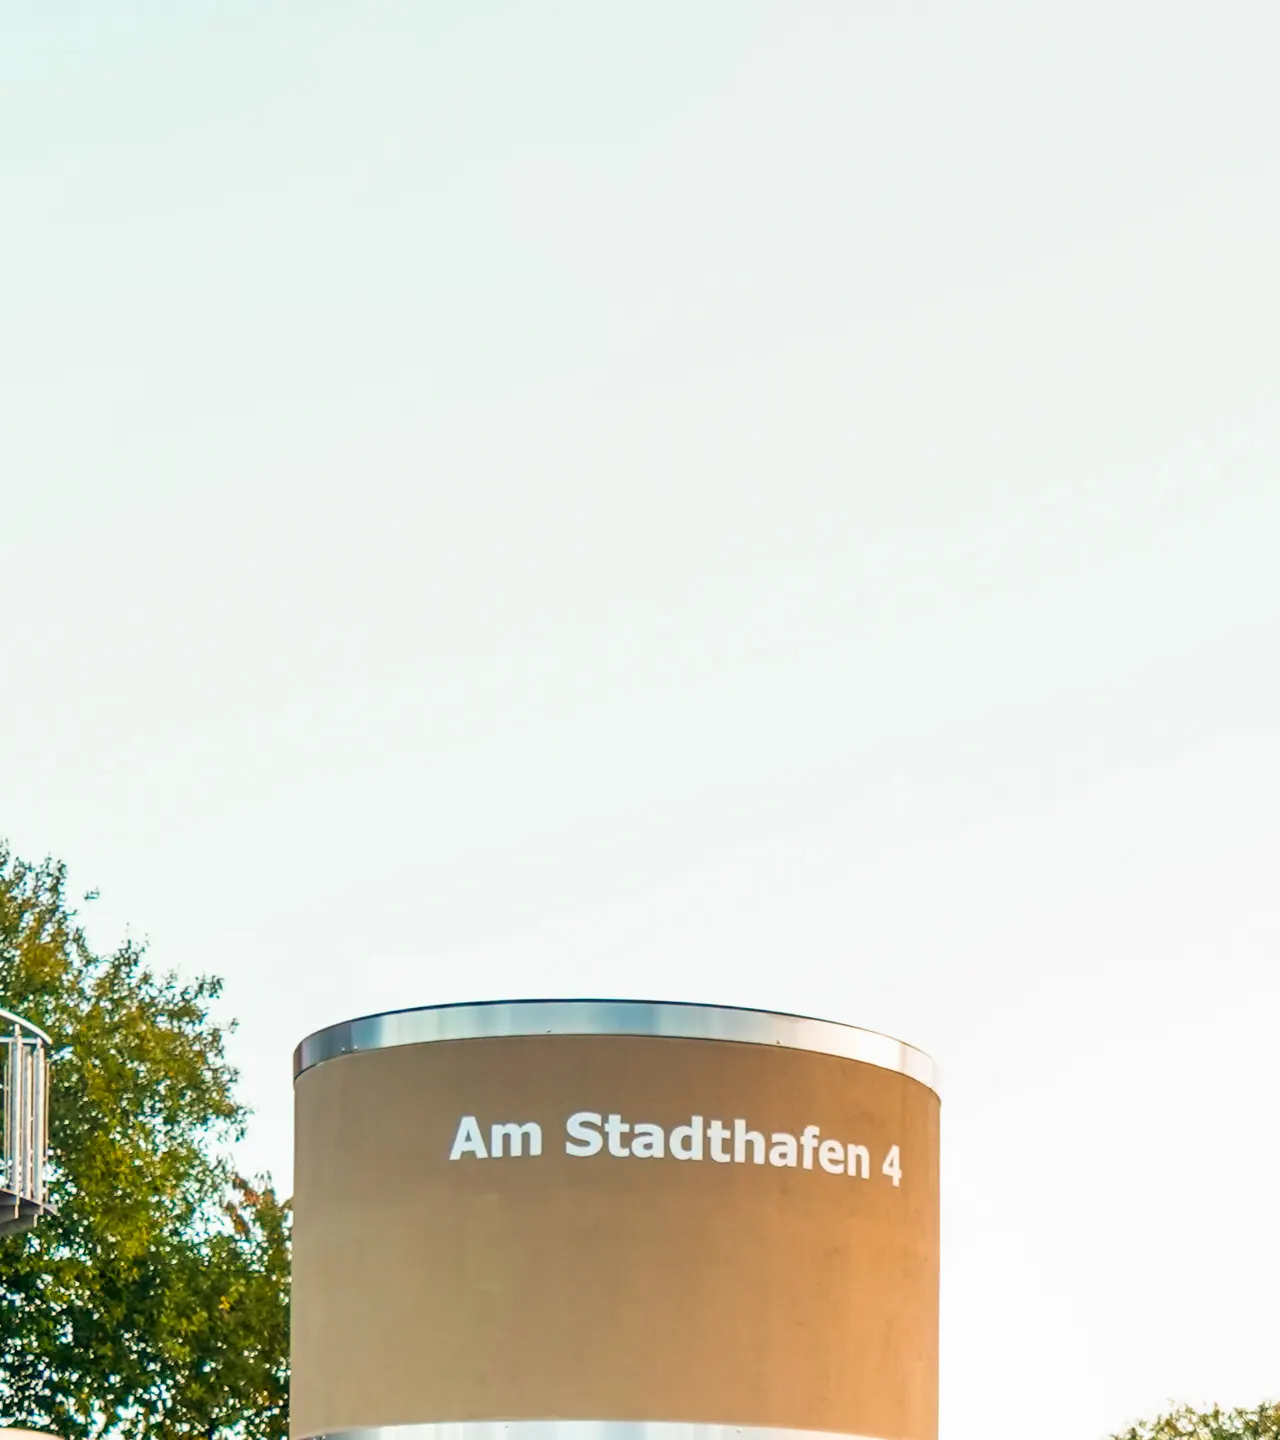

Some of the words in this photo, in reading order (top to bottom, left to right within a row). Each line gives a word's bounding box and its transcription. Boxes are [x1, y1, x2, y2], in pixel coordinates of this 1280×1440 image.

[449, 1116, 542, 1160] Am
[565, 1112, 870, 1180] Stadthafen
[881, 1145, 902, 1188] 4
